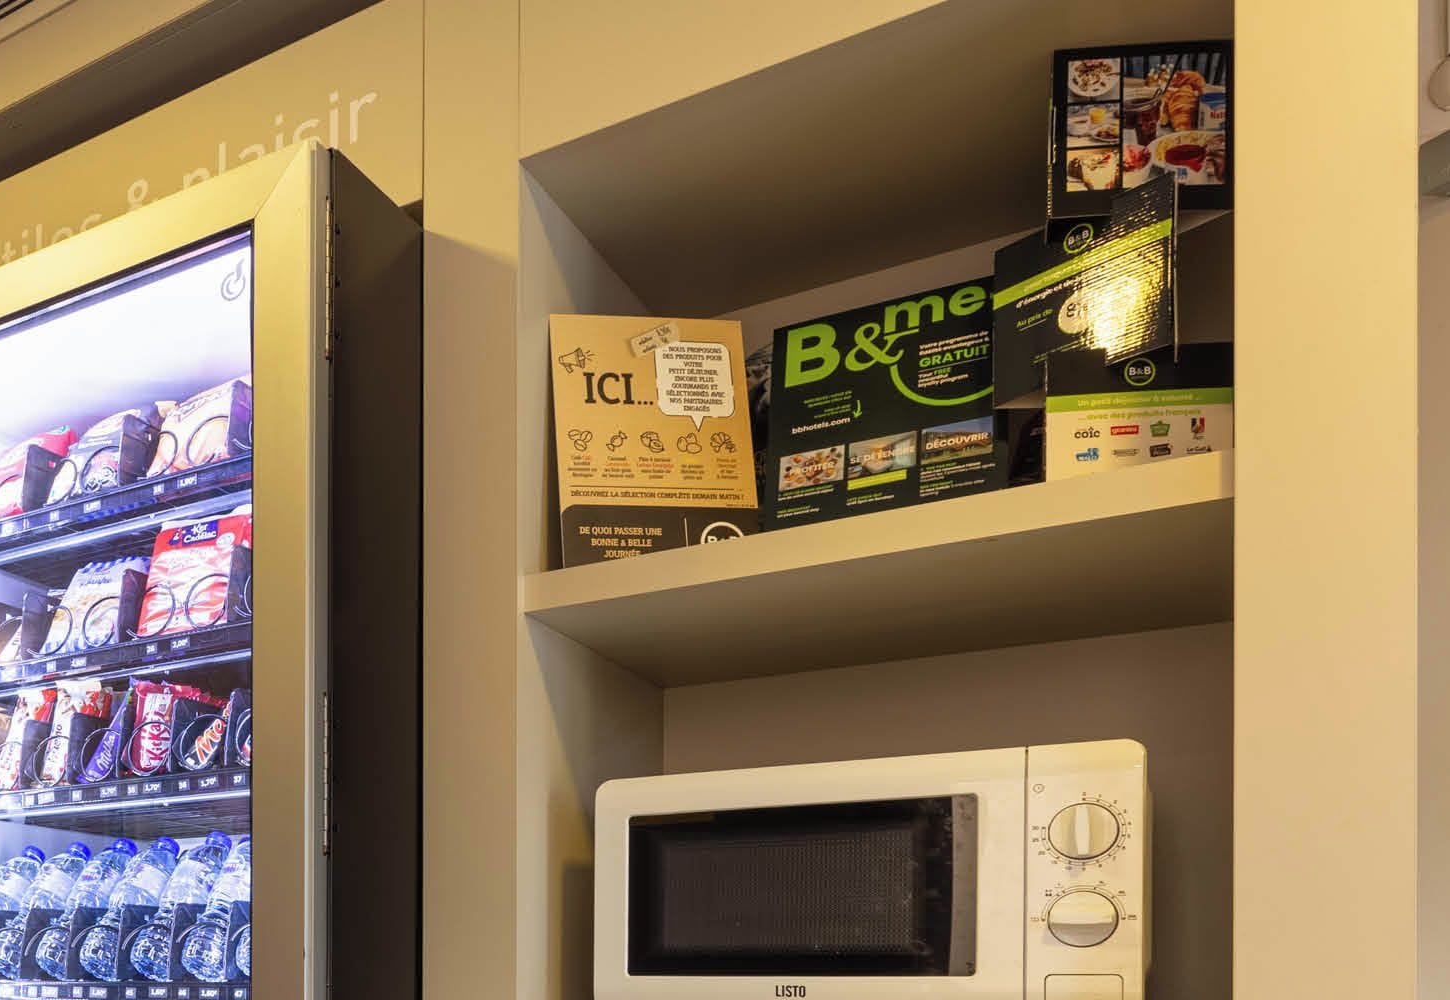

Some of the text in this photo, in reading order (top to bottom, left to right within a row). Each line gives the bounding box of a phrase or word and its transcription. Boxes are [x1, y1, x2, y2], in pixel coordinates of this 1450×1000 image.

[784, 286, 987, 388] B&me
[919, 344, 989, 367] GRATUIT
[926, 432, 989, 450] DÉCOUVRIR
[592, 527, 612, 535] QUOI
[614, 527, 644, 535] PASSER
[628, 539, 652, 547] BELLE
[775, 985, 806, 998] LISTO
